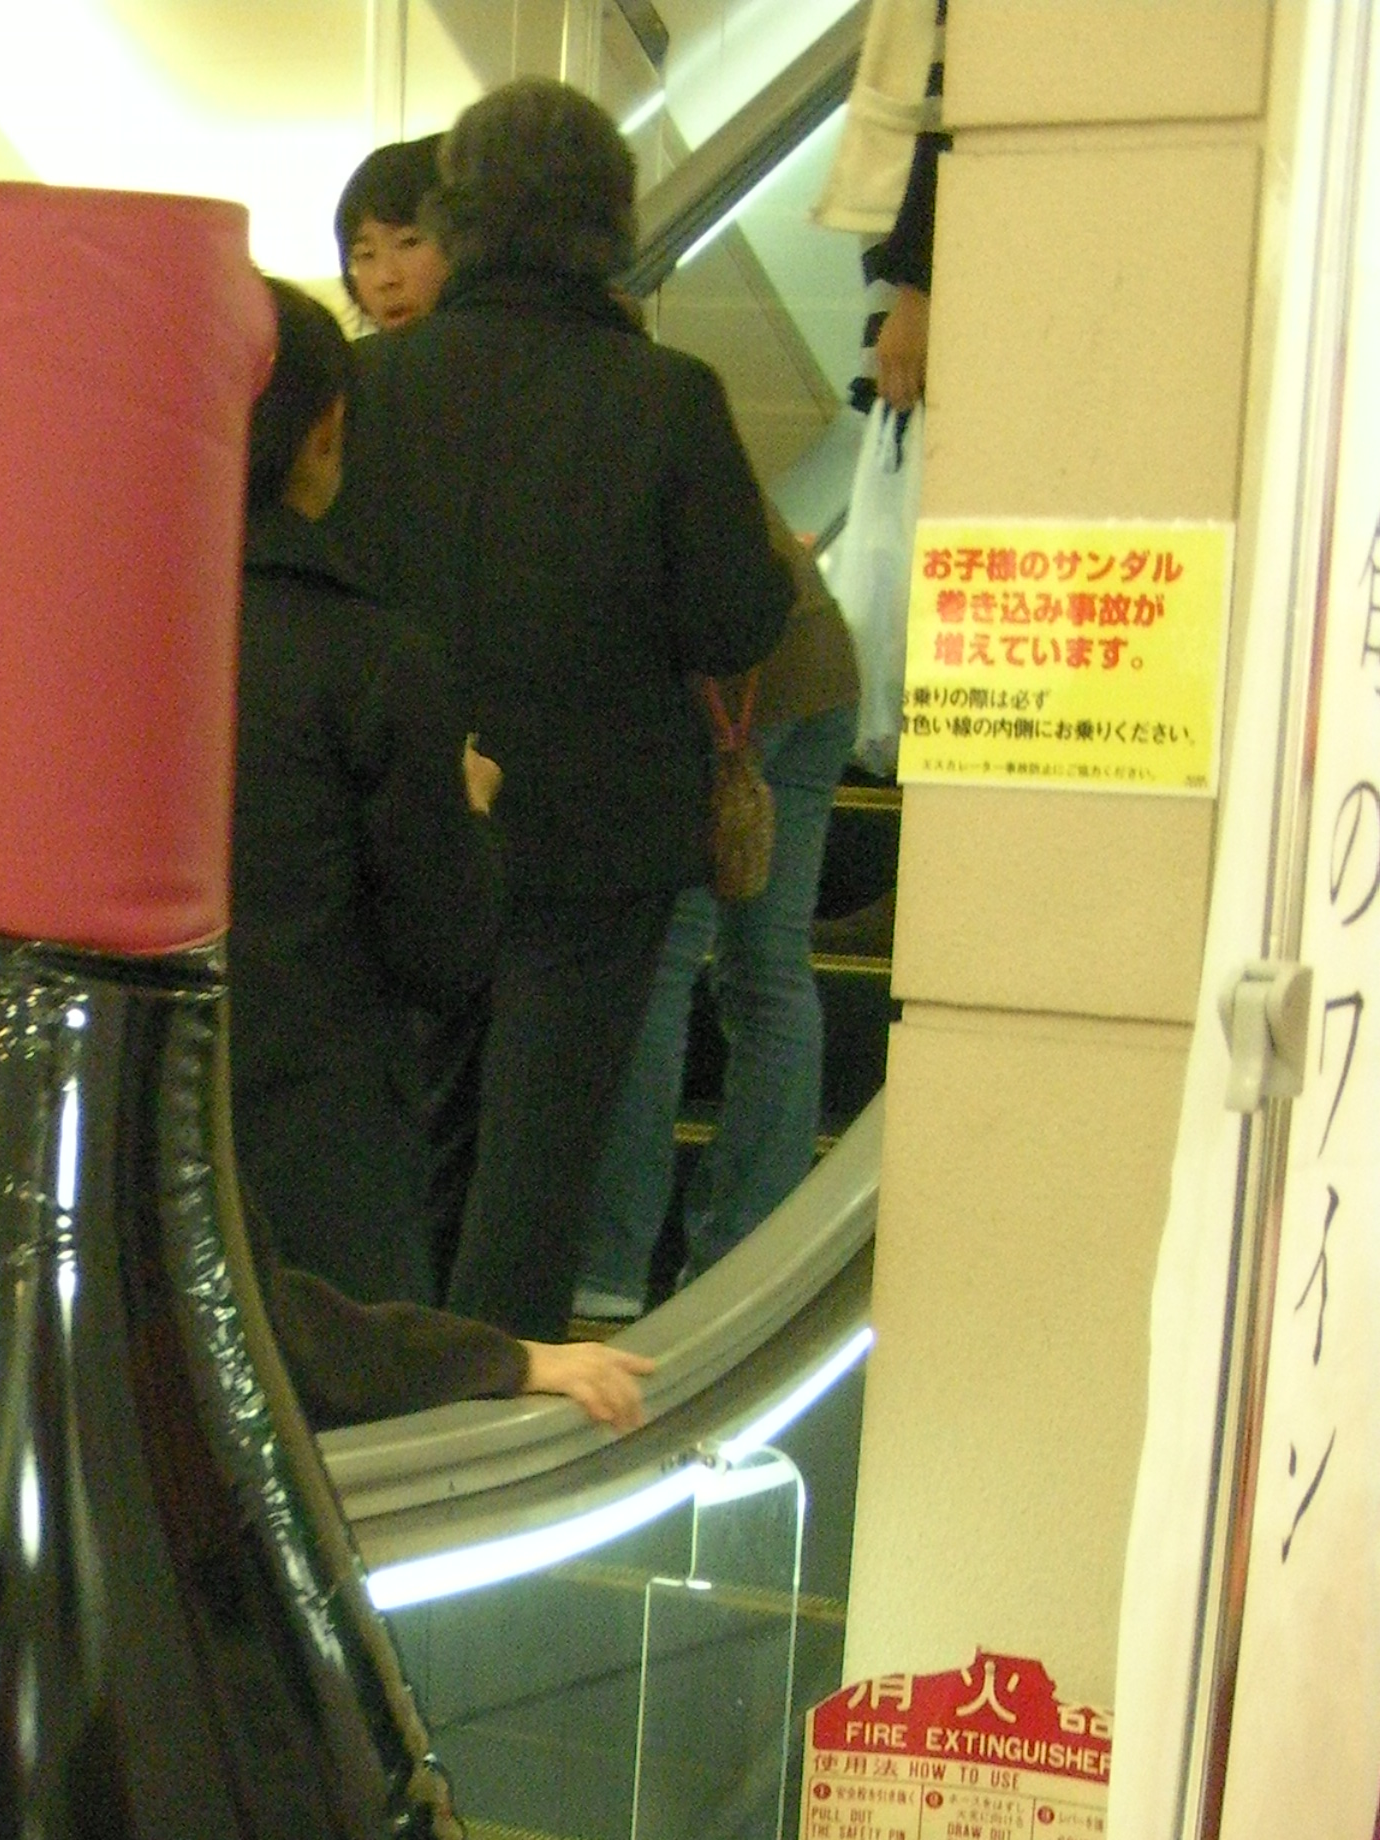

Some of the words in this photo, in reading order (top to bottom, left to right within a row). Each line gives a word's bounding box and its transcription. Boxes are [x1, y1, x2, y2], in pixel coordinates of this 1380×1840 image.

[923, 548, 1183, 584] お子様のサンダル
[936, 590, 1165, 627] 巻き込み事故が
[934, 632, 1144, 670] 増えています。
[844, 1720, 909, 1749] FIRE
[812, 1755, 899, 1780] 使用法
[908, 1760, 947, 1783] HOW
[959, 1765, 979, 1784] TO
[990, 1767, 1021, 1790] USE
[812, 1806, 839, 1822] PULL
[850, 1809, 873, 1824] OUT
[812, 1824, 830, 1838] THE
